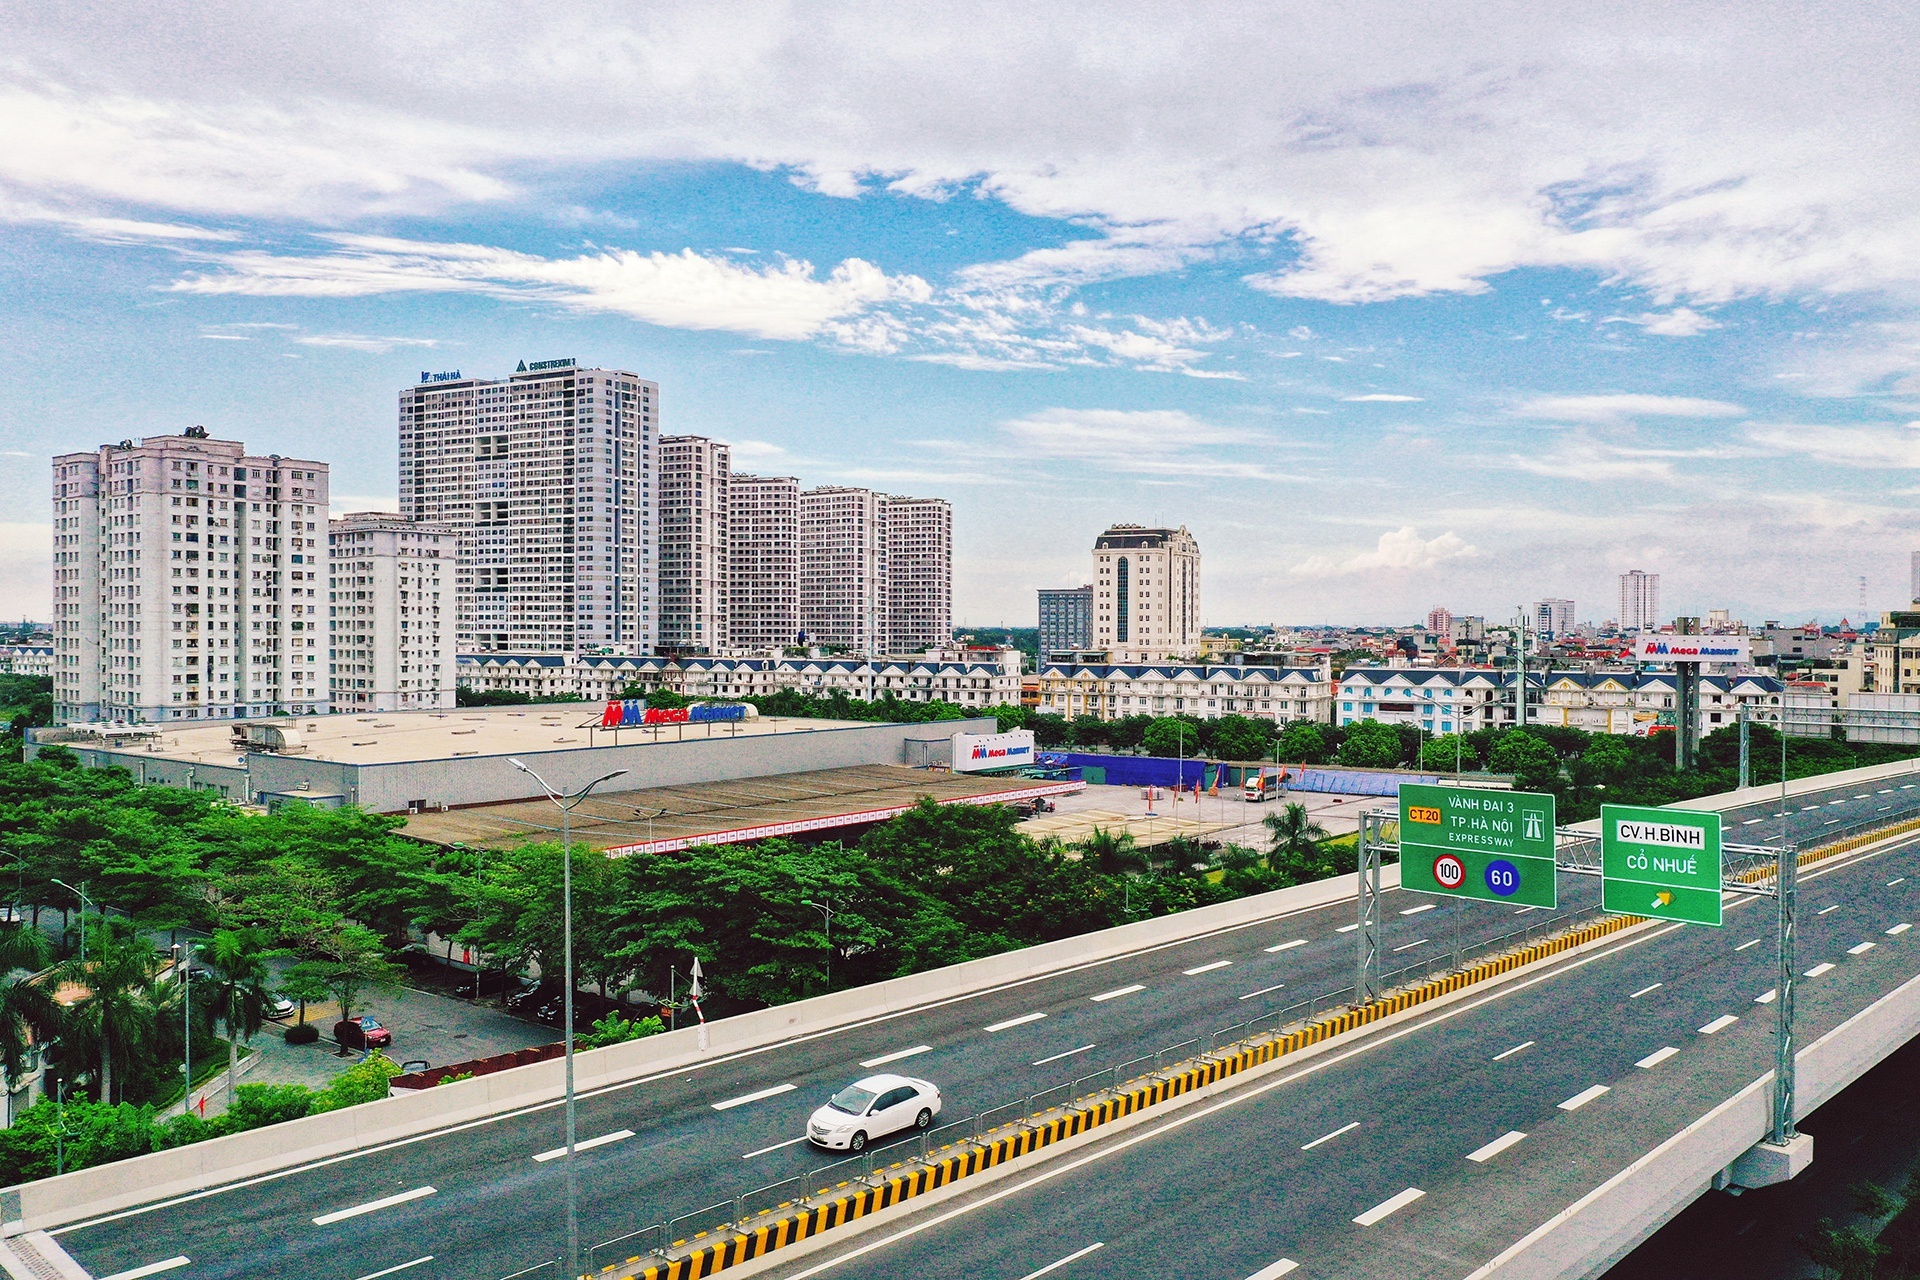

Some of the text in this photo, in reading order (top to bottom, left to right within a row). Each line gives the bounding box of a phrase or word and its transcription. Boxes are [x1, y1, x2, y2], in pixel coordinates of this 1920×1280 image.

[450, 369, 461, 379] HÀ
[1670, 647, 1698, 655] Mega
[1699, 647, 1739, 656] Market
[643, 707, 689, 723] Mega
[689, 705, 747, 721] Market
[988, 749, 1006, 758] Mega
[1006, 746, 1030, 756] Market
[1448, 794, 1514, 813] VÀNH ĐAI 3
[1409, 809, 1439, 822] CT.20
[1450, 815, 1513, 834] TP.HÀ NỘI
[1448, 832, 1514, 847] EXPRESSWAY
[1620, 824, 1700, 845] CV.H.BÌNH
[1626, 848, 1697, 875] CỔ NHUẾ
[1439, 863, 1459, 880] 100
[1491, 869, 1513, 887] 60
